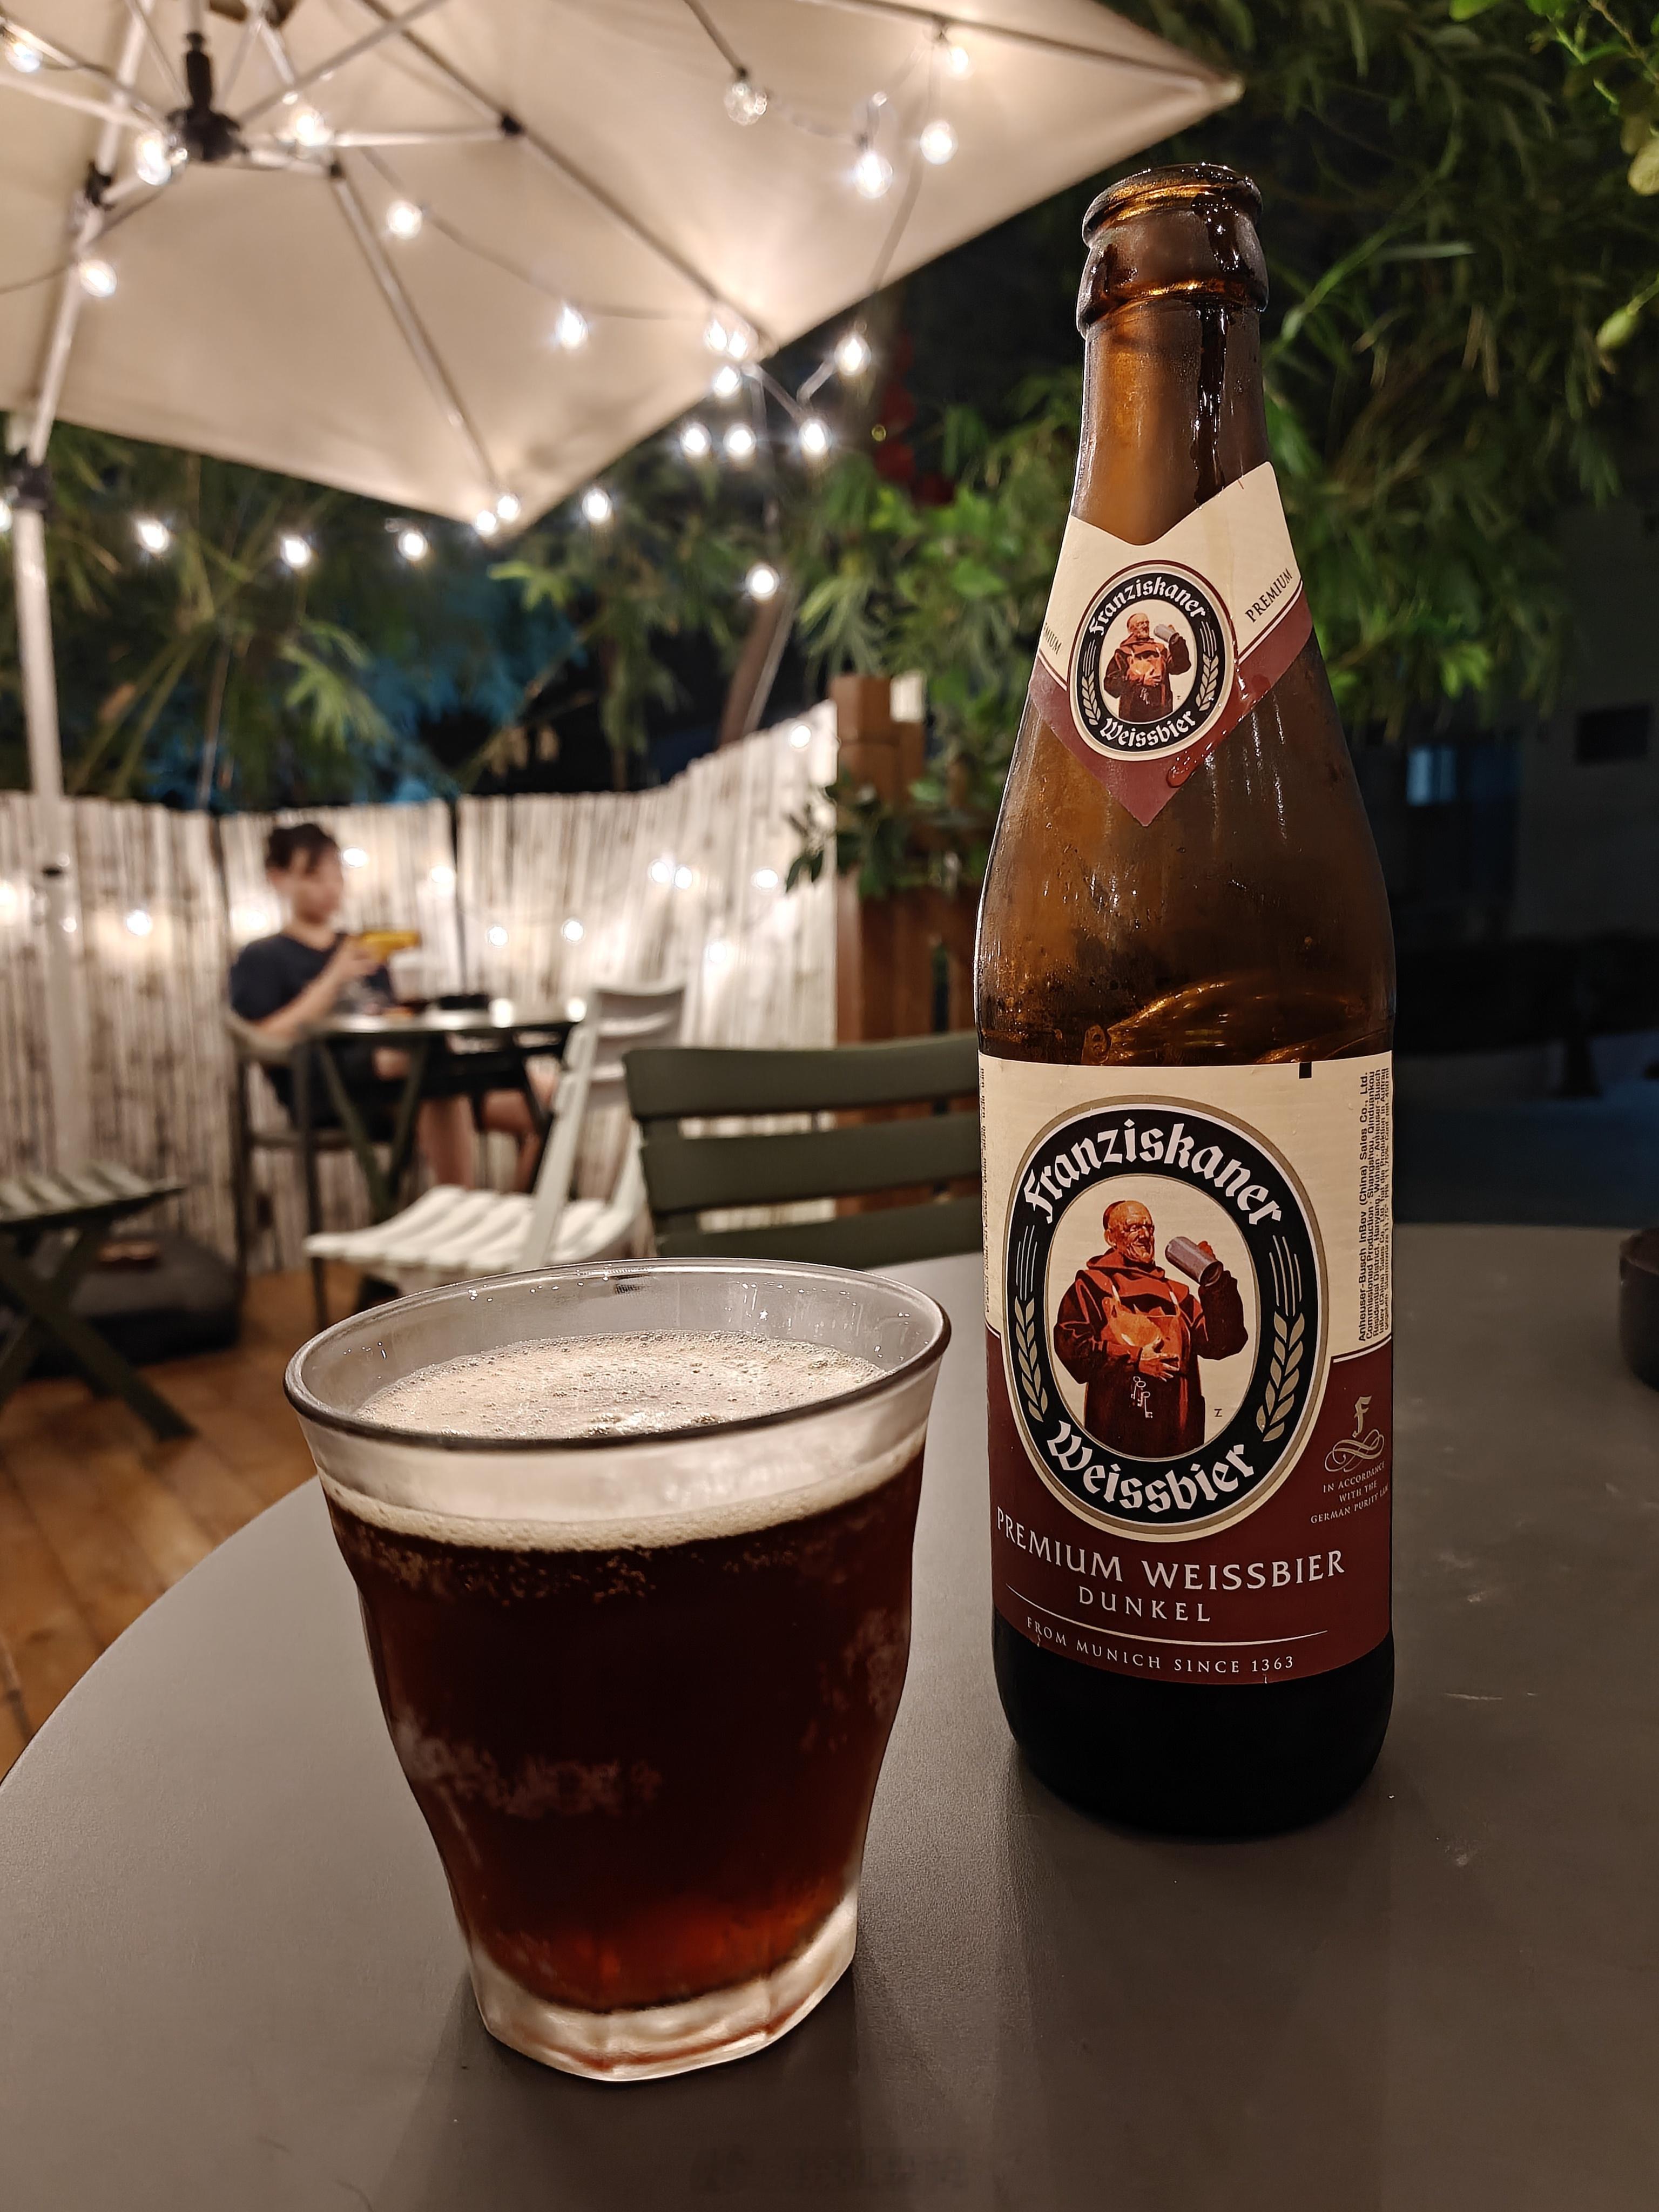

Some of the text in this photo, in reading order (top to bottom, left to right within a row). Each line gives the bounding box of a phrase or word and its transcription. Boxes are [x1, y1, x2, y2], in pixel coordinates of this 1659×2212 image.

[1089, 576, 1206, 636] Franziskaner
[1244, 568, 1293, 623] PREMIUM
[1100, 711, 1196, 747] Weissbier
[1024, 1119, 1282, 1225] Franziskaner
[1359, 1165, 1368, 1205] (China)
[1046, 1419, 1256, 1513] Weissbier
[1323, 1482, 1334, 1493] IN
[1310, 1506, 1351, 1524] GERMAN
[1354, 1492, 1379, 1512] PURITY
[1339, 1480, 1378, 1502] WITH THE
[996, 1506, 1345, 1590] PREMIUM WEISSBIER
[1078, 1586, 1211, 1622] DUNKEL
[1026, 1617, 1294, 1673] FROM MUNICH SINCE 1363
